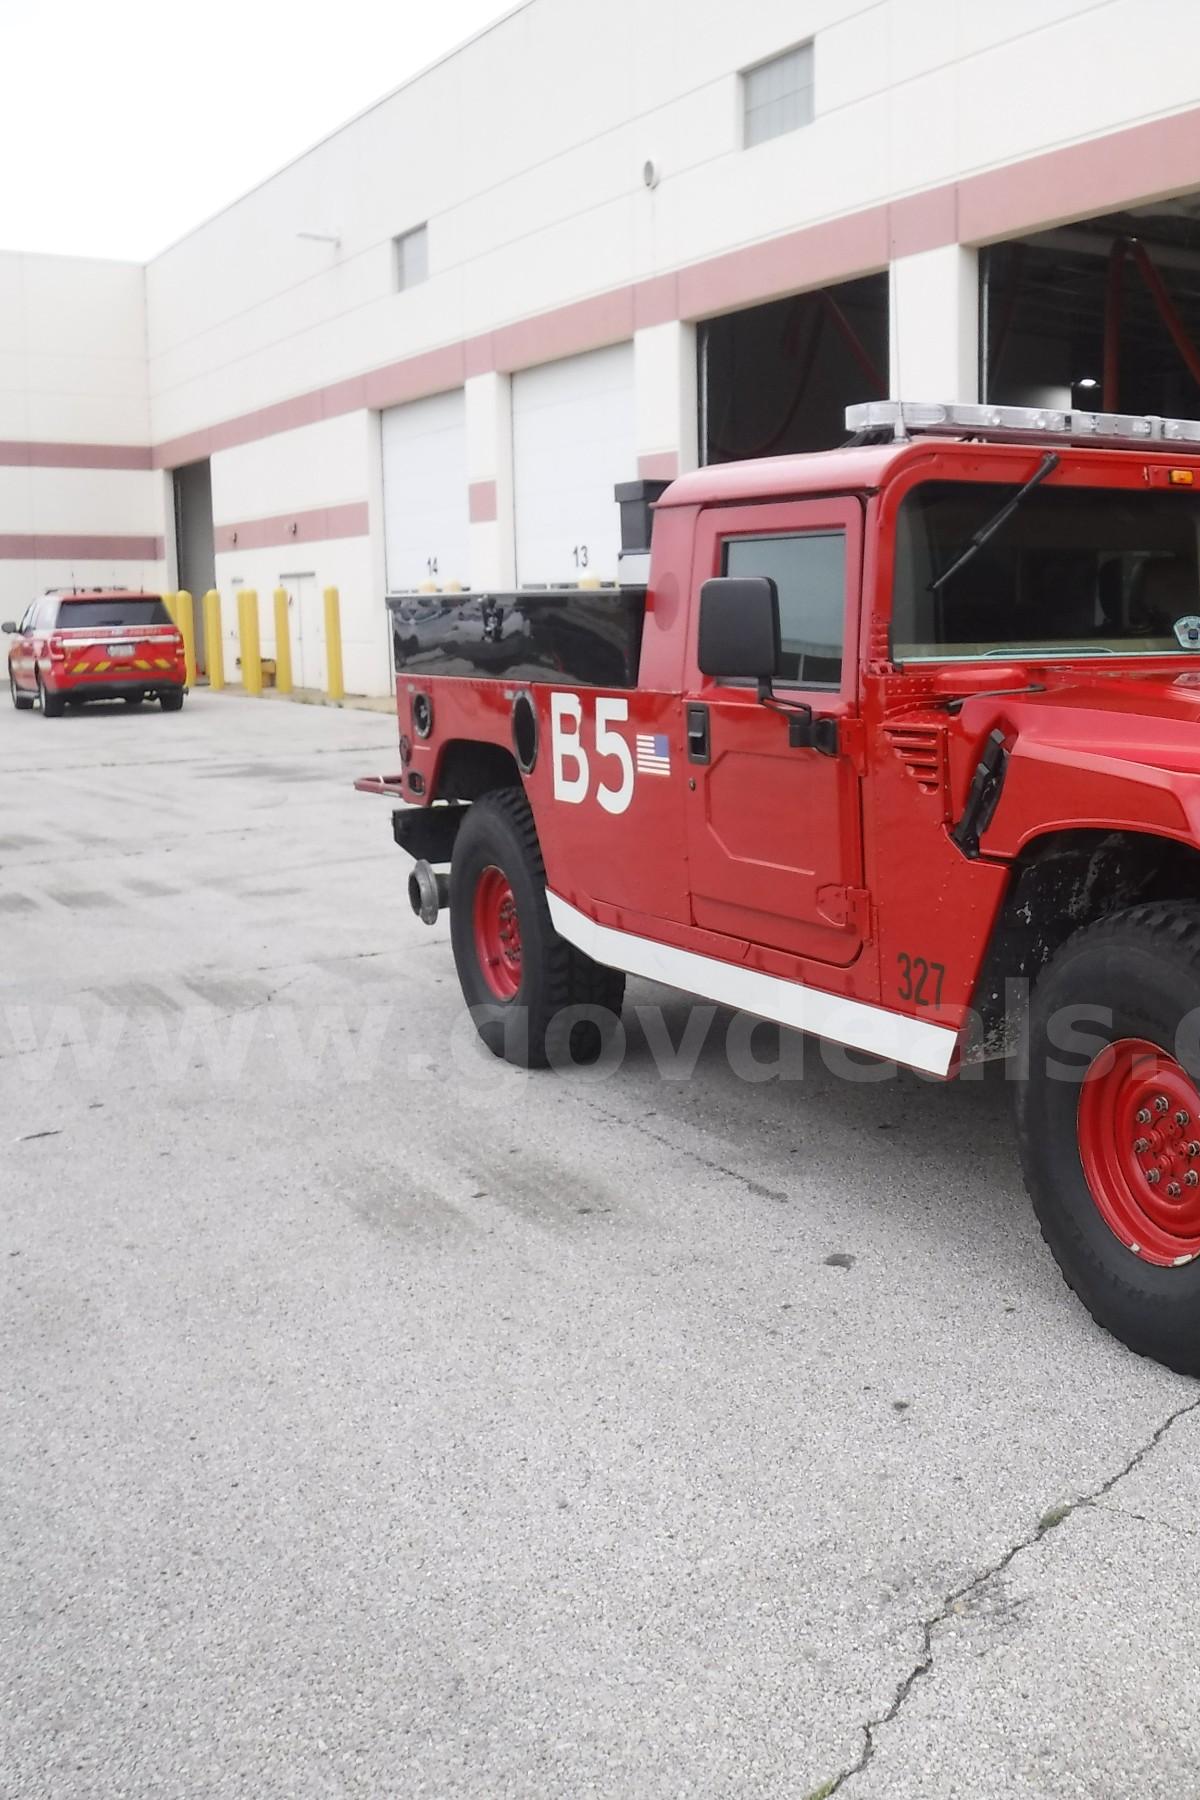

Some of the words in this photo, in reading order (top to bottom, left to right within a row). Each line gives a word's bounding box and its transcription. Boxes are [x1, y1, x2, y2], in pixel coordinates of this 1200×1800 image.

[426, 557, 439, 576] 14
[573, 545, 589, 568] 13
[550, 692, 635, 815] B5
[896, 952, 946, 1011] 327
